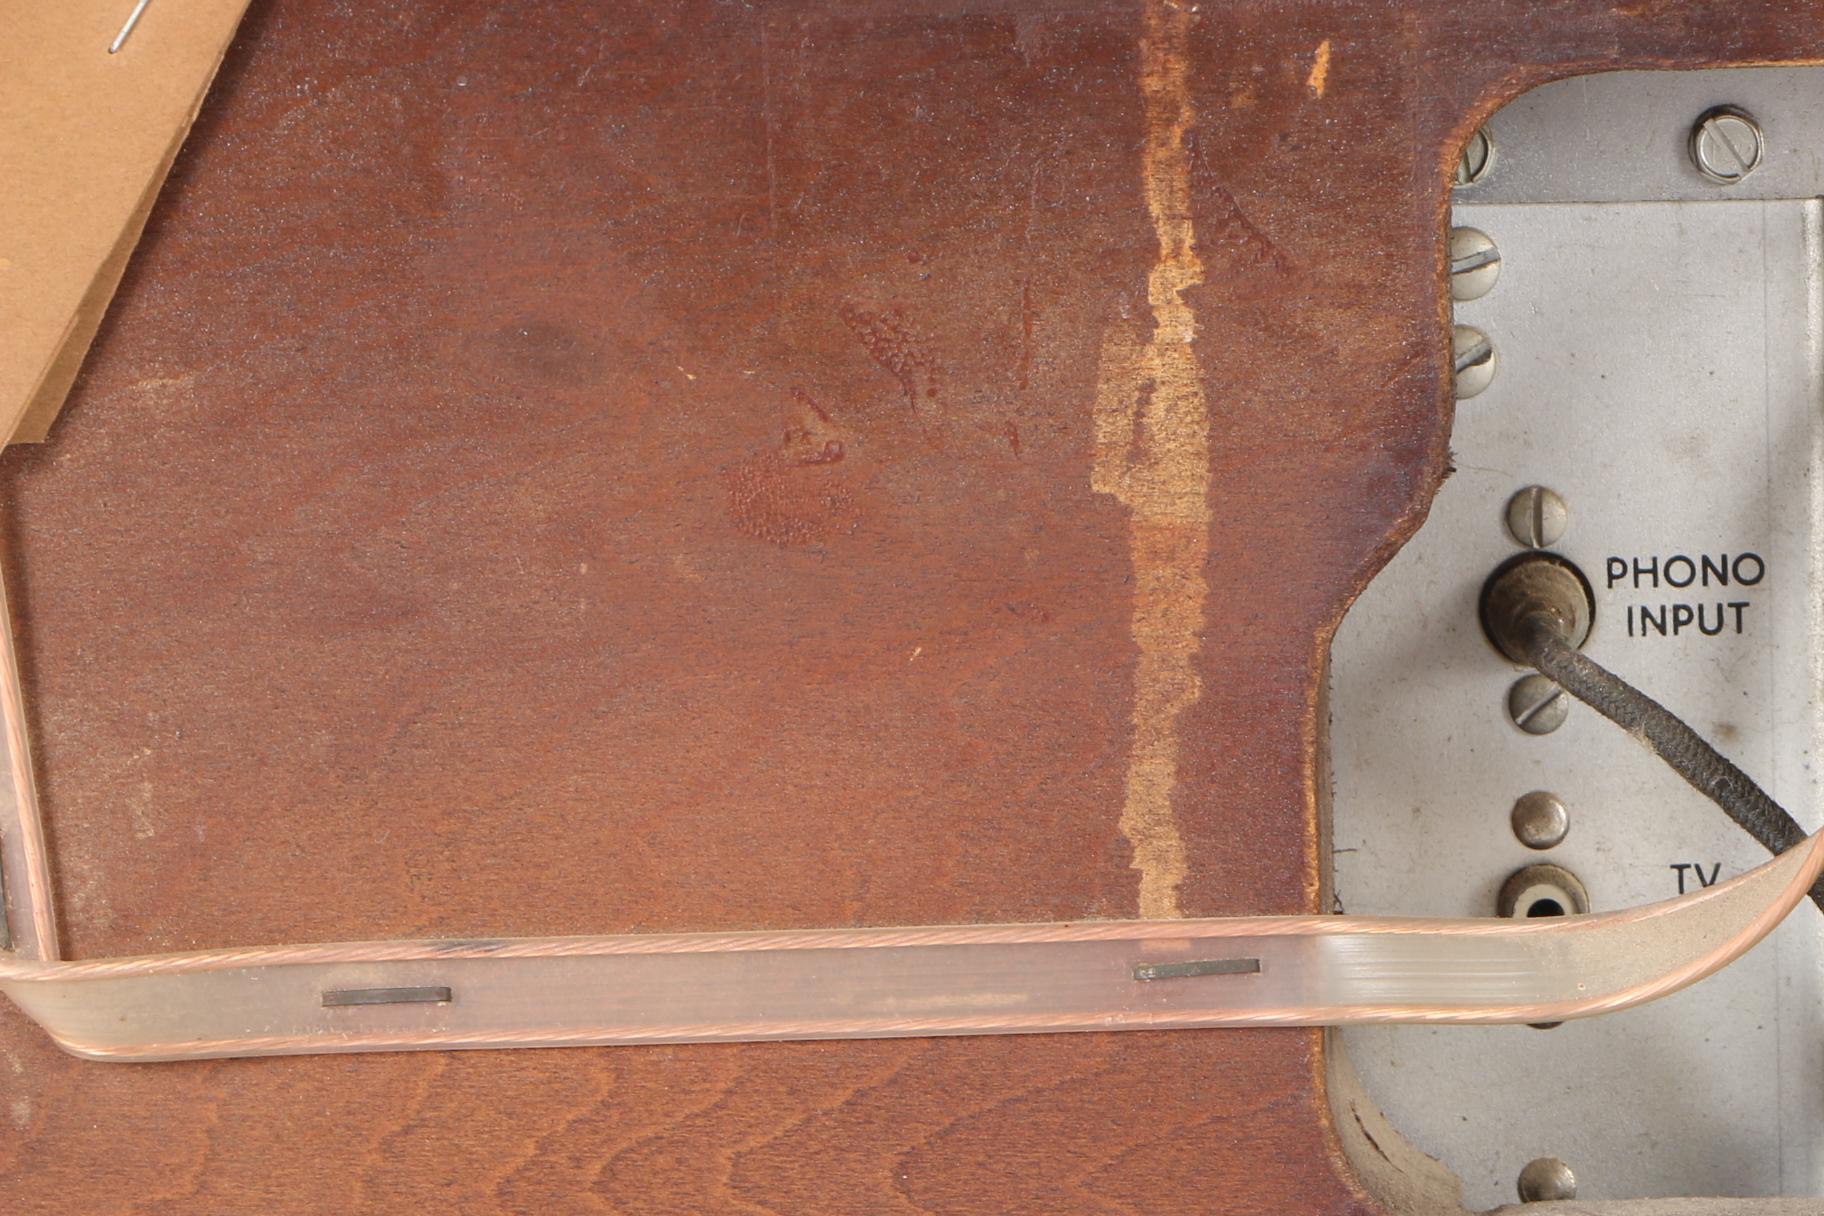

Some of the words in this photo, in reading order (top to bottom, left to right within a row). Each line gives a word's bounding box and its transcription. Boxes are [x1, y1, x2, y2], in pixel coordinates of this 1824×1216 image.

[1606, 552, 1765, 589] PHONO
[1627, 601, 1750, 637] INPUT
[1669, 862, 1722, 895] TV
